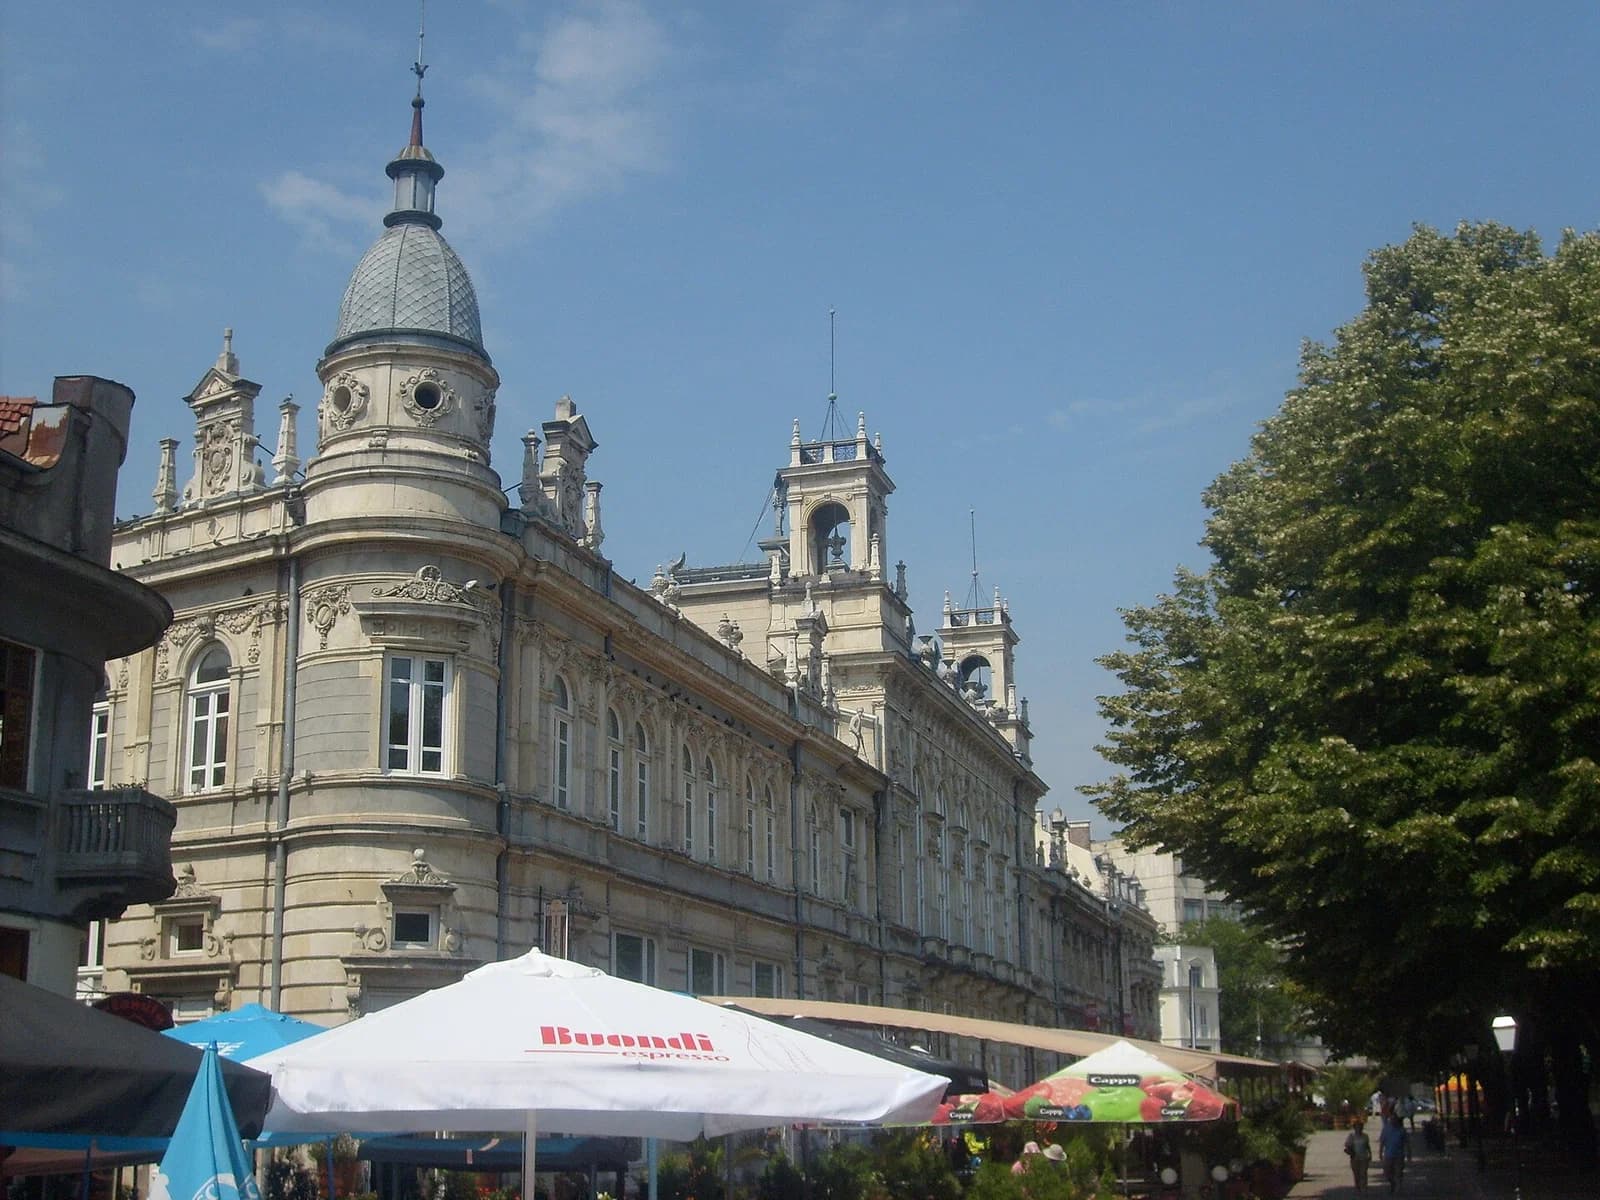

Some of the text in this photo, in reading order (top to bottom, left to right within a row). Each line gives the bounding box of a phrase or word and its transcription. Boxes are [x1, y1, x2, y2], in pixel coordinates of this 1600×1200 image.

[540, 1026, 714, 1052] Buondi
[621, 1051, 731, 1062] espresso
[1090, 1076, 1136, 1085] Cappy
